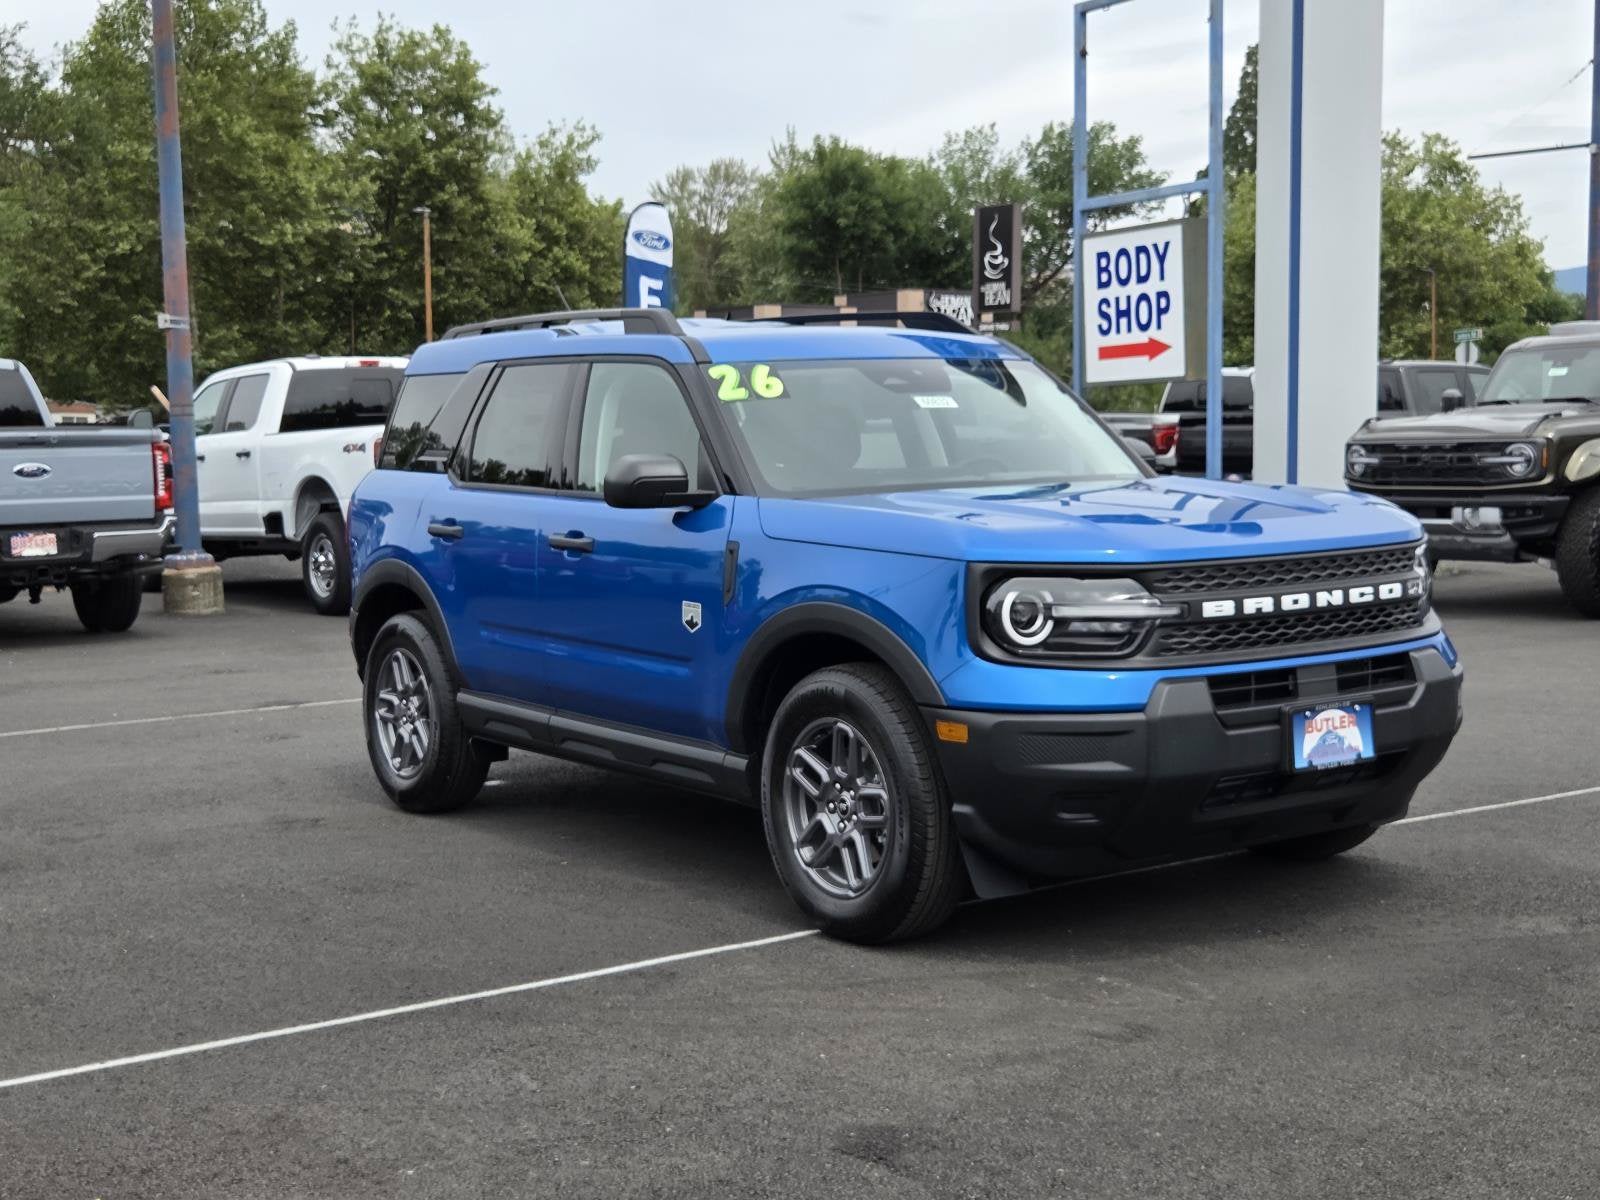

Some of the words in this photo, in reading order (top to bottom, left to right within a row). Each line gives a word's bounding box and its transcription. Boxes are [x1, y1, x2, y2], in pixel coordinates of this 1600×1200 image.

[640, 231, 665, 250] Ford
[1096, 241, 1170, 290] BODY
[1097, 291, 1171, 336] SHOP
[707, 364, 784, 402] 26
[1202, 583, 1402, 618] BRONCO
[1305, 714, 1357, 734] BUTLER
